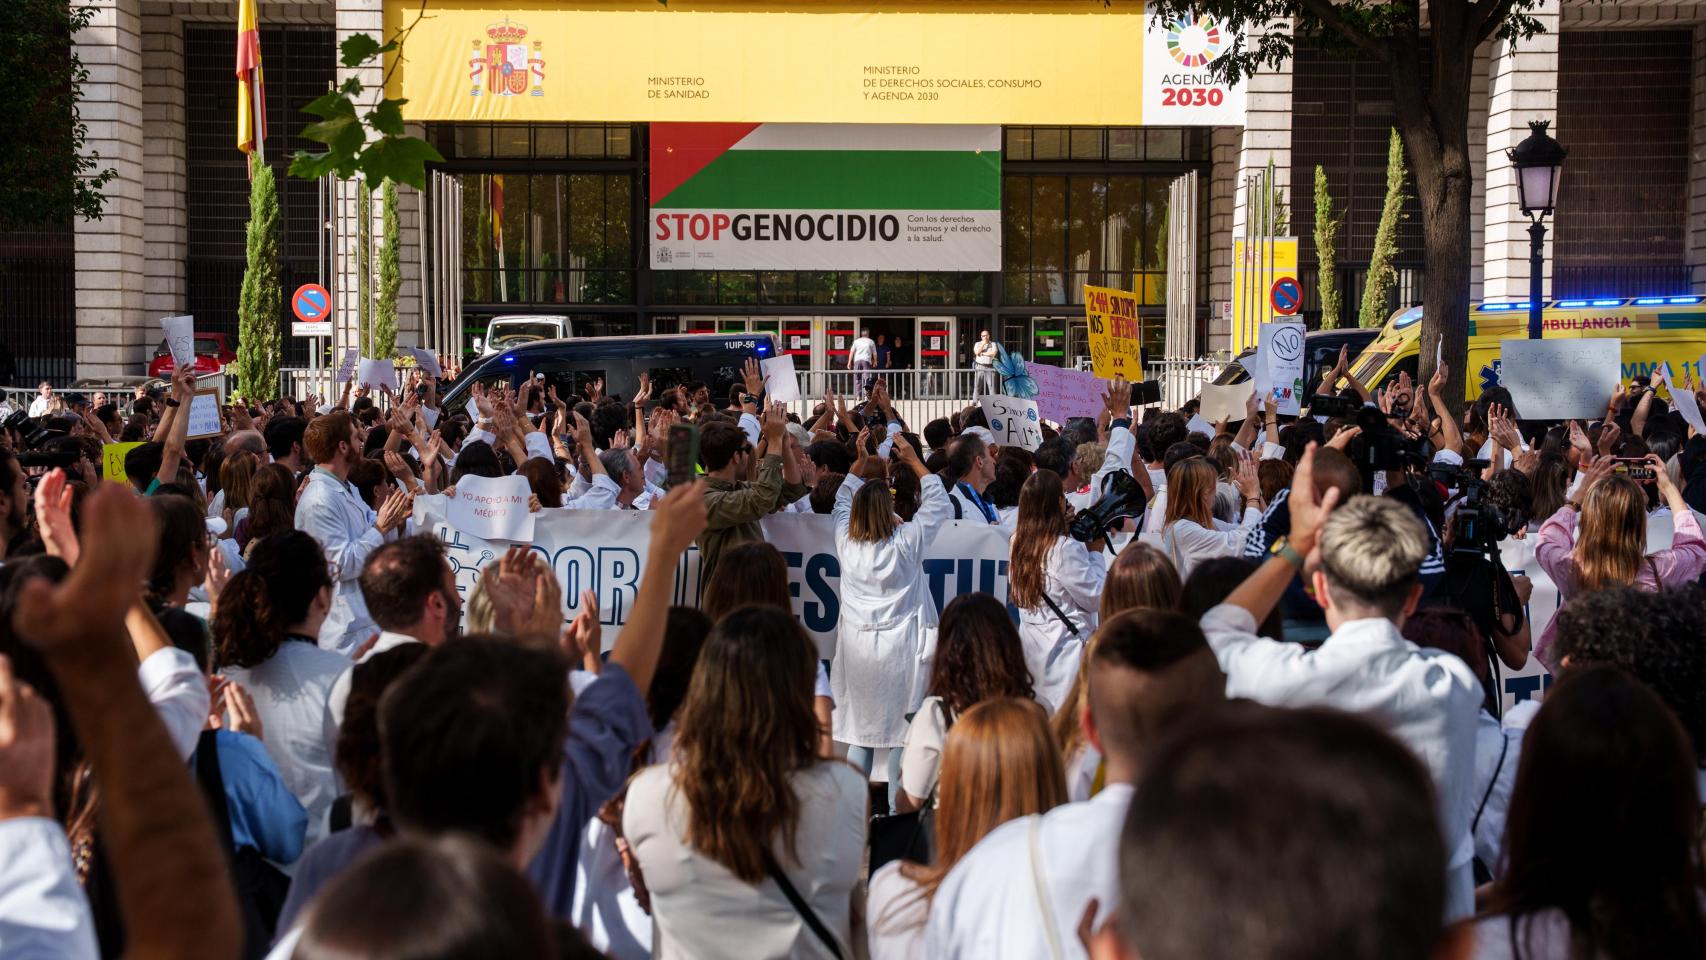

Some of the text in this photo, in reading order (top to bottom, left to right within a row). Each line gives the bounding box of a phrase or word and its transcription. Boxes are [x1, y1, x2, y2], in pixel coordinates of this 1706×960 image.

[864, 66, 920, 75] MINISTERIO
[648, 77, 705, 86] MINISTERIO
[864, 79, 1042, 89] DE DERECHOS SOCIALES, CONSUMO
[1161, 74, 1224, 85] AGENDA
[647, 89, 710, 99] DE SANIDAD
[864, 92, 939, 100] Y AGENDA 2030
[1161, 88, 1224, 106] 2030
[907, 215, 975, 223] Con los derechos
[655, 213, 900, 242] STOPGENOCIDIO
[907, 224, 942, 232] humanos
[944, 226, 949, 234] y
[914, 234, 920, 242] la
[922, 234, 944, 242] salud.
[1089, 291, 1109, 315] 24H
[1089, 314, 1104, 335] NOS
[1527, 317, 1631, 331] MBULANCIA
[725, 341, 756, 350] 1UIP-56
[1273, 334, 1299, 355] NO
[462, 491, 474, 501] YO
[475, 495, 502, 505] APOYO
[511, 495, 523, 504] MI
[474, 507, 506, 518] MÉDICO
